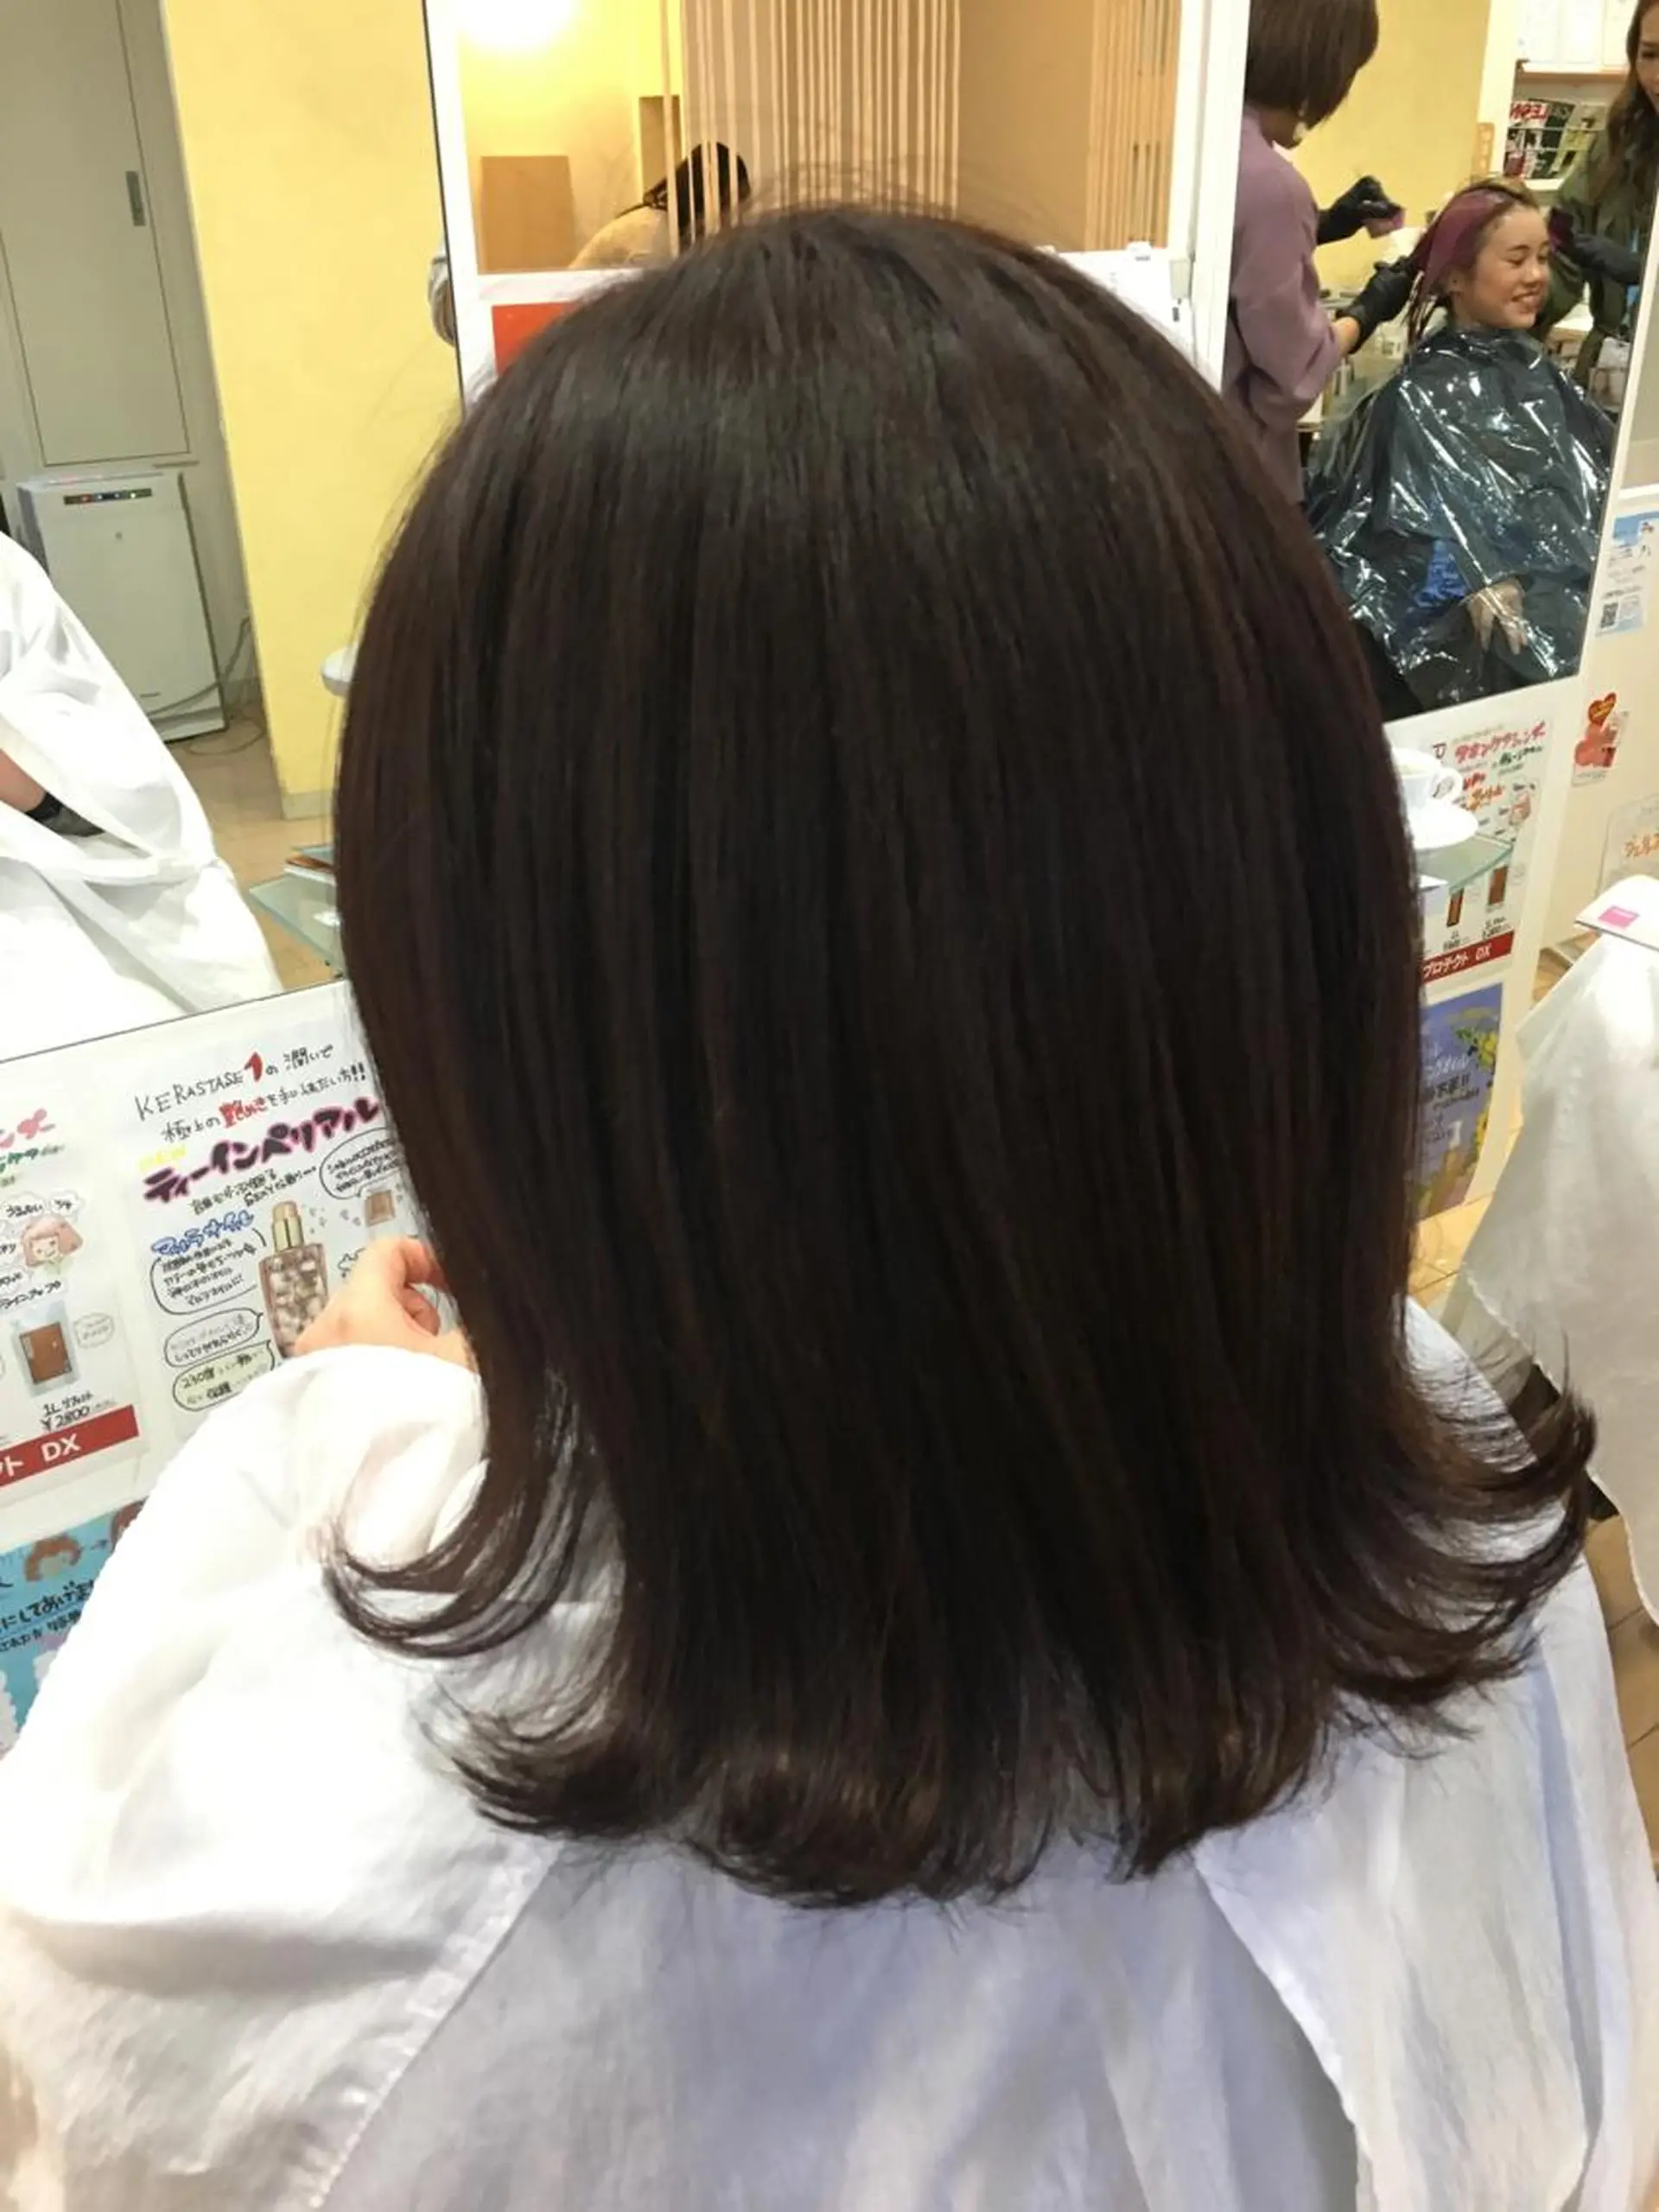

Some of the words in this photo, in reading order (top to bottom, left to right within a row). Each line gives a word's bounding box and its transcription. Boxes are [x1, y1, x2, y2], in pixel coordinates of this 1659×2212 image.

[1475, 943, 1492, 961] DX
[134, 1070, 243, 1121] KERASTASE
[143, 1096, 379, 1203] ティーインペリアル
[0, 1455, 23, 1477] ト
[41, 1433, 81, 1461] DX
